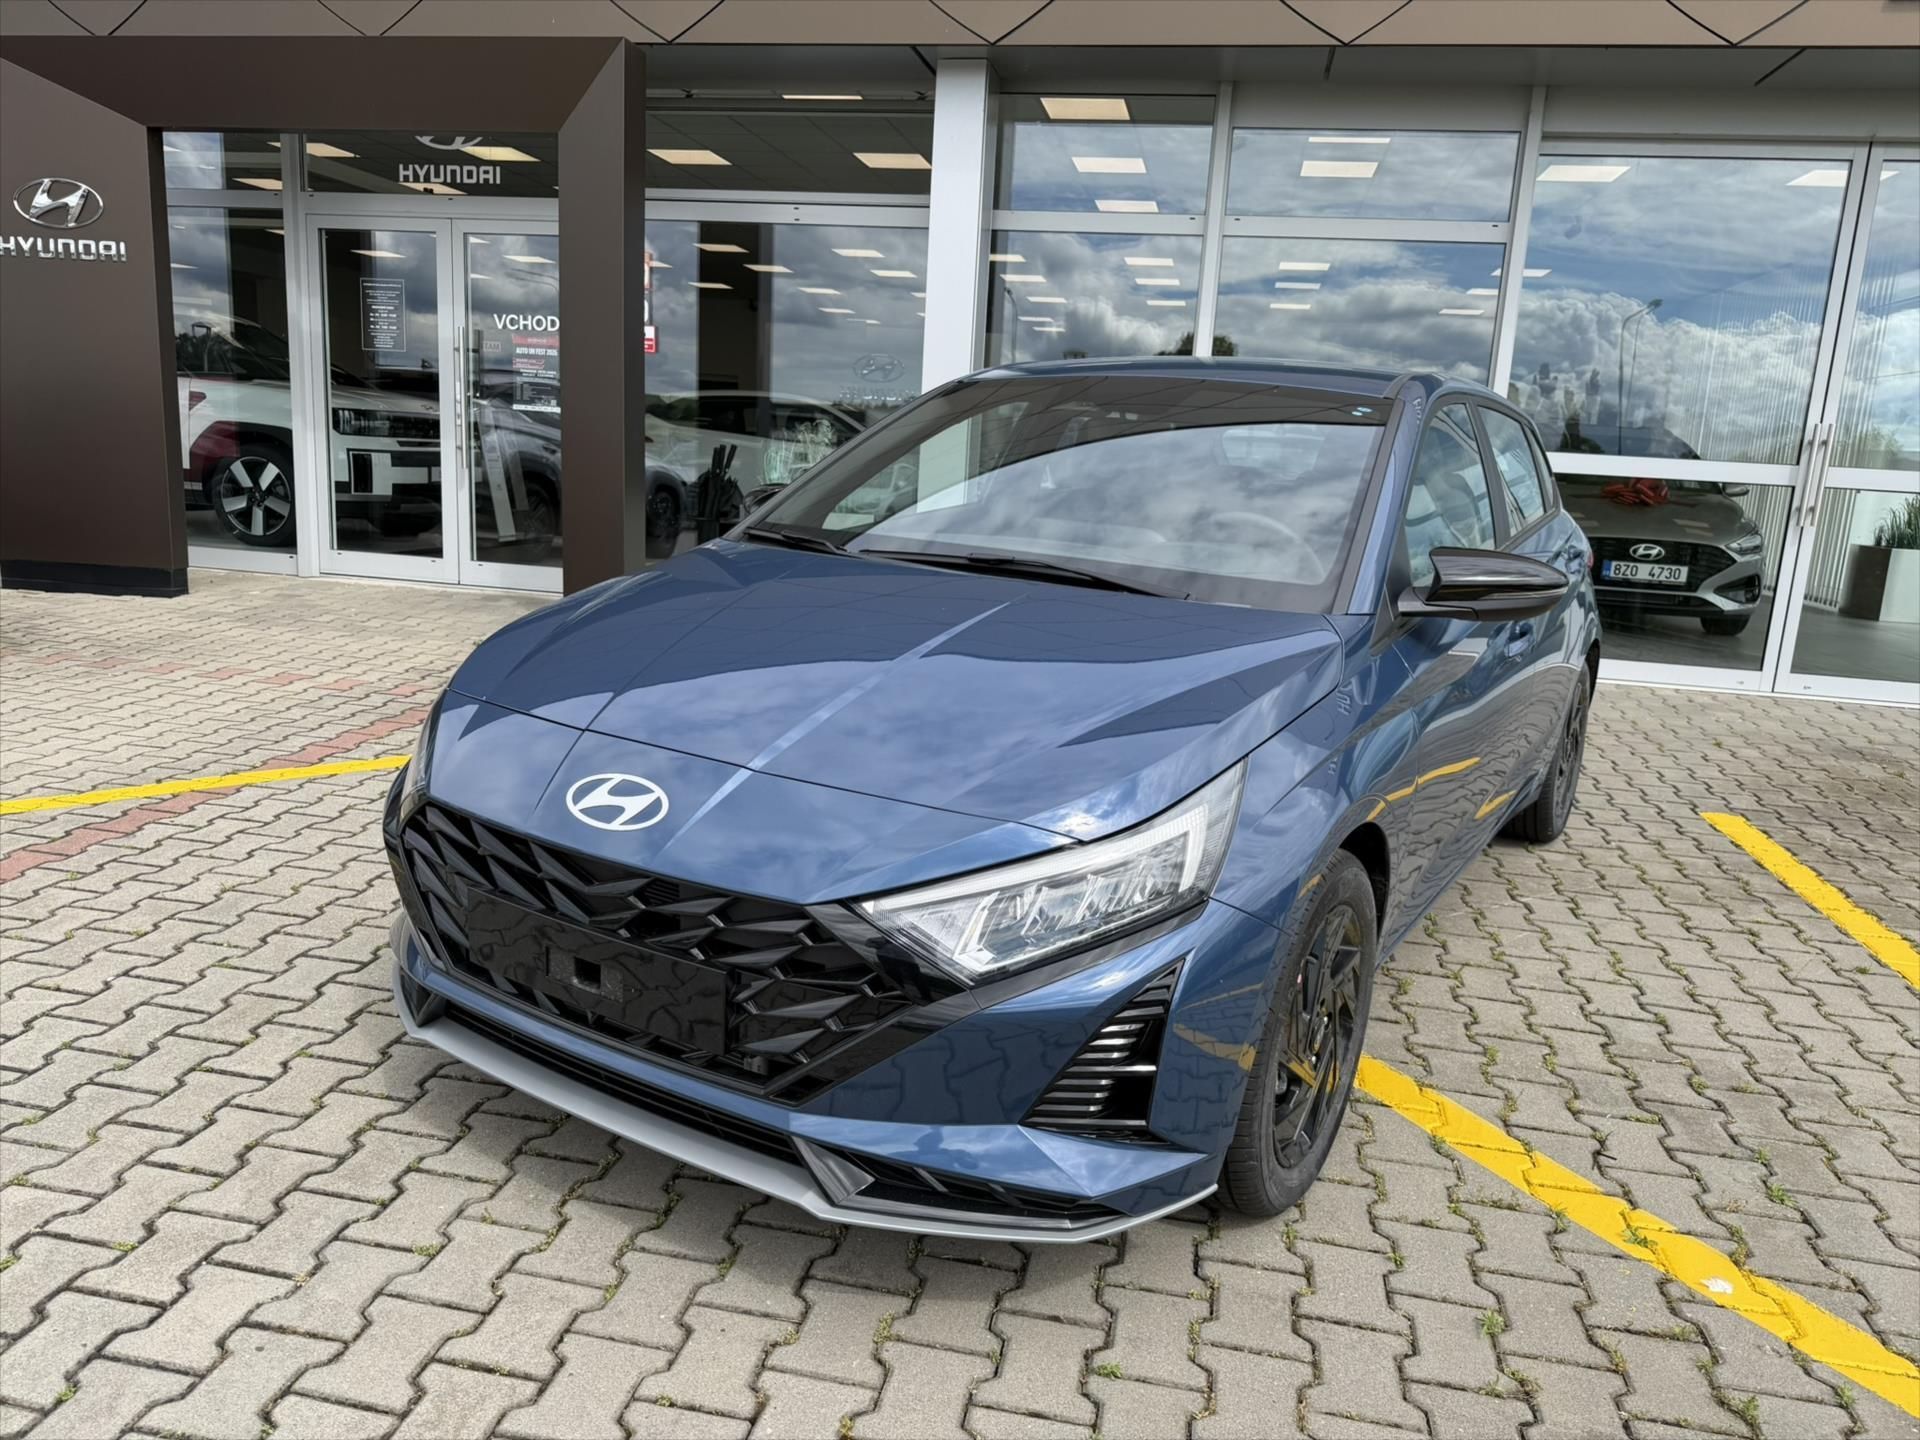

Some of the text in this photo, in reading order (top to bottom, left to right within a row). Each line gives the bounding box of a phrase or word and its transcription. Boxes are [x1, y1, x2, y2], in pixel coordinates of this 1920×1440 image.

[398, 163, 501, 184] HYUNDAI
[0, 235, 127, 262] HYUNDAI
[493, 313, 560, 332] VCHOD
[1648, 566, 1681, 580] 4730
